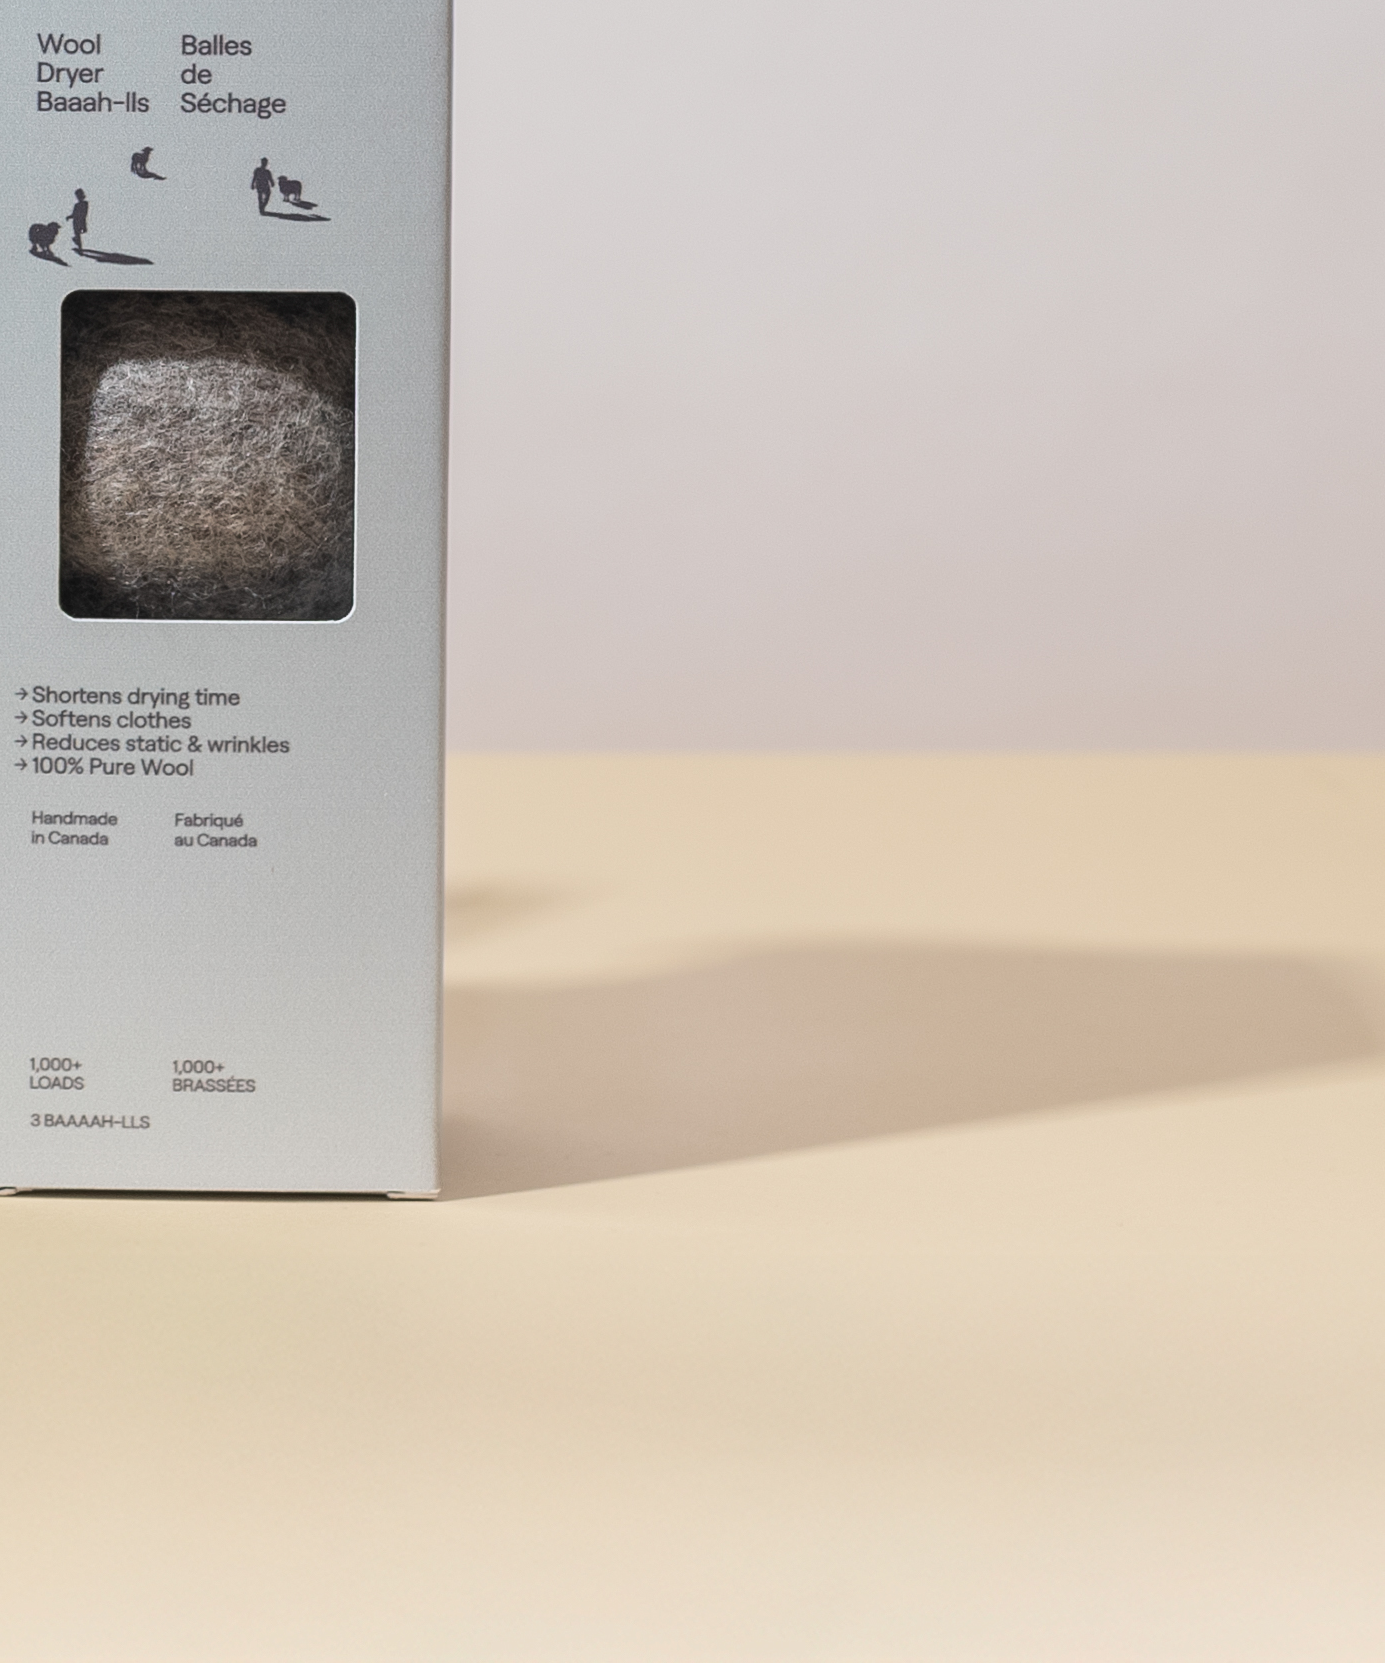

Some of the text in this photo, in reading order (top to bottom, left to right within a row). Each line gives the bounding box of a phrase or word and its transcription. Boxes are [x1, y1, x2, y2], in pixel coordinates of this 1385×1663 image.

[36, 32, 101, 55] Wool
[181, 34, 253, 56] Balles
[37, 61, 105, 89] Dryer
[180, 63, 213, 85] de
[37, 90, 150, 113] Baaah-lls
[180, 92, 287, 120] Séchage
[32, 685, 241, 710] Shortens drying time
[31, 708, 192, 730] Softens clothes
[32, 732, 290, 754] Reduces static & wrinkles
[32, 756, 194, 777] 100% Pure Wool
[31, 810, 118, 827] Handmade
[174, 812, 244, 831] Fabriqué
[31, 830, 109, 846] in Canada
[174, 832, 258, 848] au Canada
[29, 1057, 82, 1073] 1,000+
[172, 1059, 225, 1076] 1,000+
[29, 1075, 85, 1091] LOADS
[172, 1075, 256, 1093] BRASSÉES
[30, 1113, 151, 1130] 3 BAAAAH-LLS
